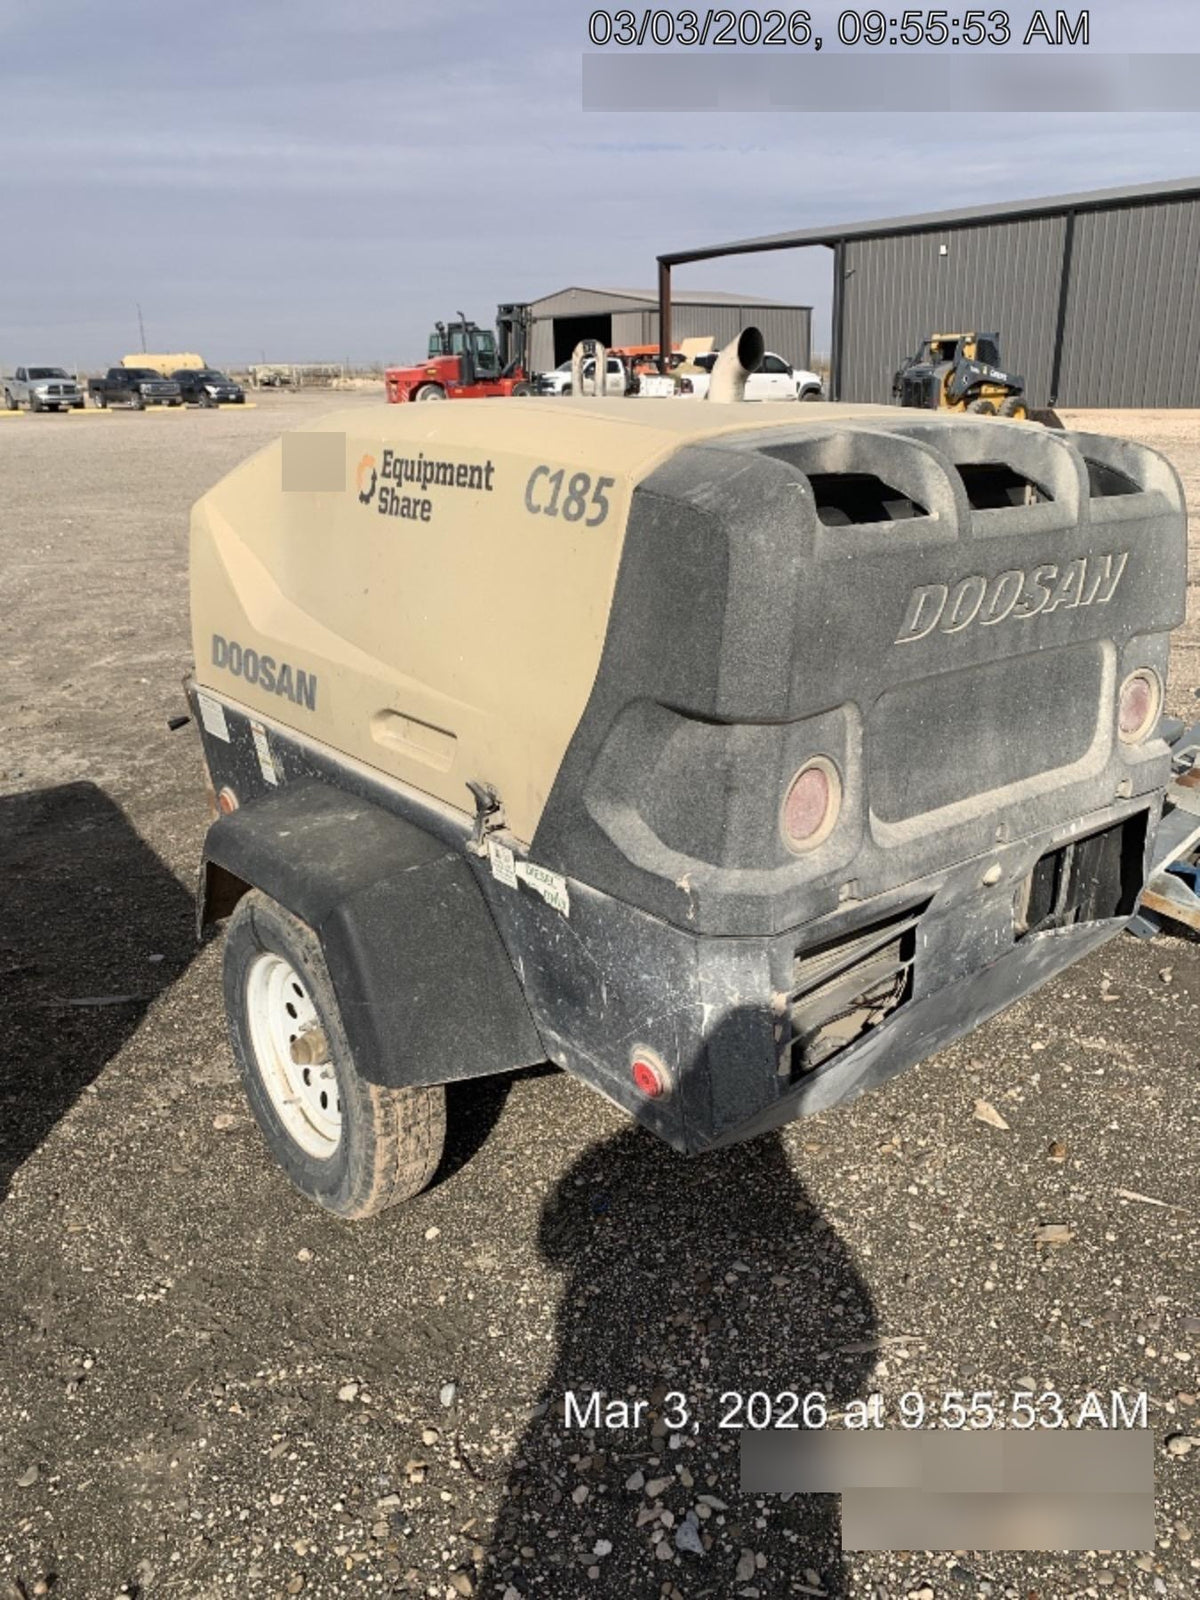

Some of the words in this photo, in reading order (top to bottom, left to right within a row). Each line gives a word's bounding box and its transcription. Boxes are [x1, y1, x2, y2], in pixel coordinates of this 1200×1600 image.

[381, 449, 495, 488] Equipment
[524, 465, 615, 527] C185
[378, 488, 432, 521] Share
[894, 552, 1129, 645] DOOSAN
[212, 634, 317, 711] DOOSAN
